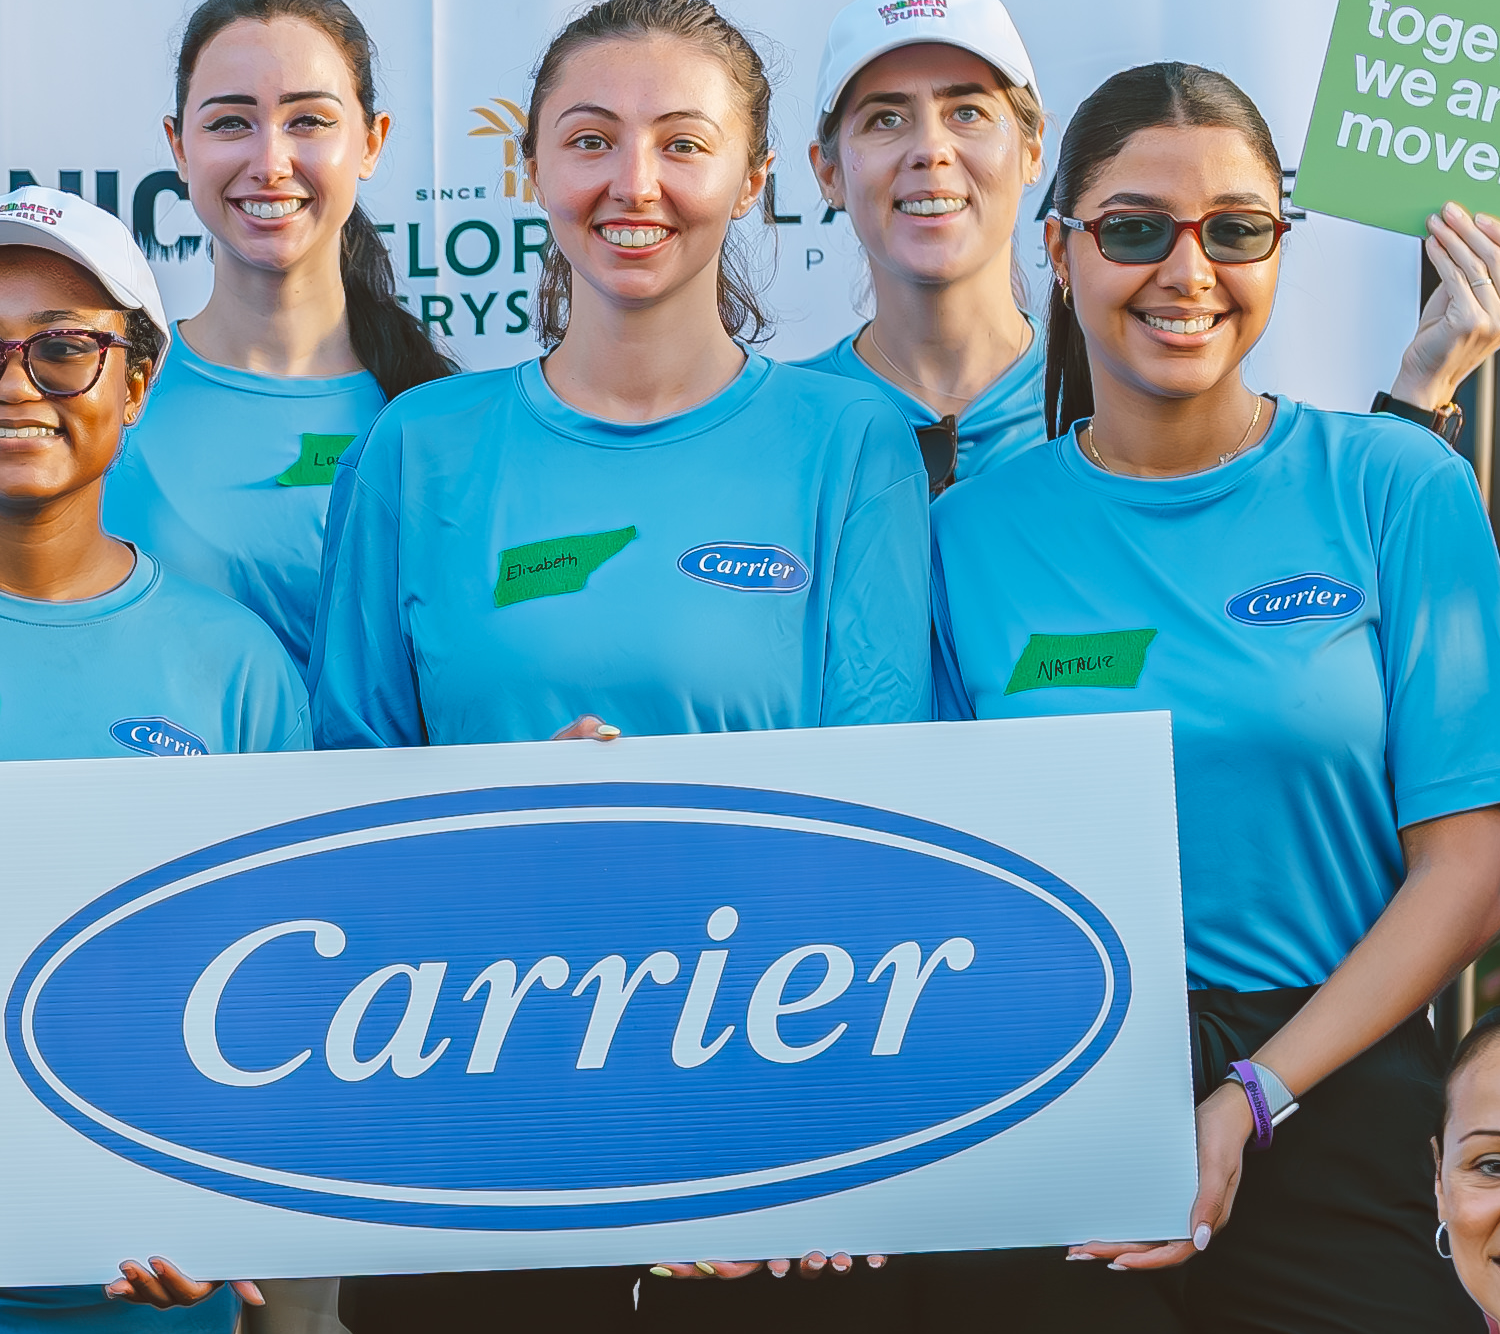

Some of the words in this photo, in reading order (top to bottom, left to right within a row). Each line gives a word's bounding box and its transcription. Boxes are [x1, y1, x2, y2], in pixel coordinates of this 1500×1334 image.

[1354, 54, 1437, 108] we
[415, 186, 487, 201] SINCE
[313, 452, 340, 467] La
[505, 553, 578, 582] Elizabeth
[699, 553, 795, 581] Carrier
[1246, 585, 1347, 617] Carrier
[181, 905, 976, 1090] Carrier
